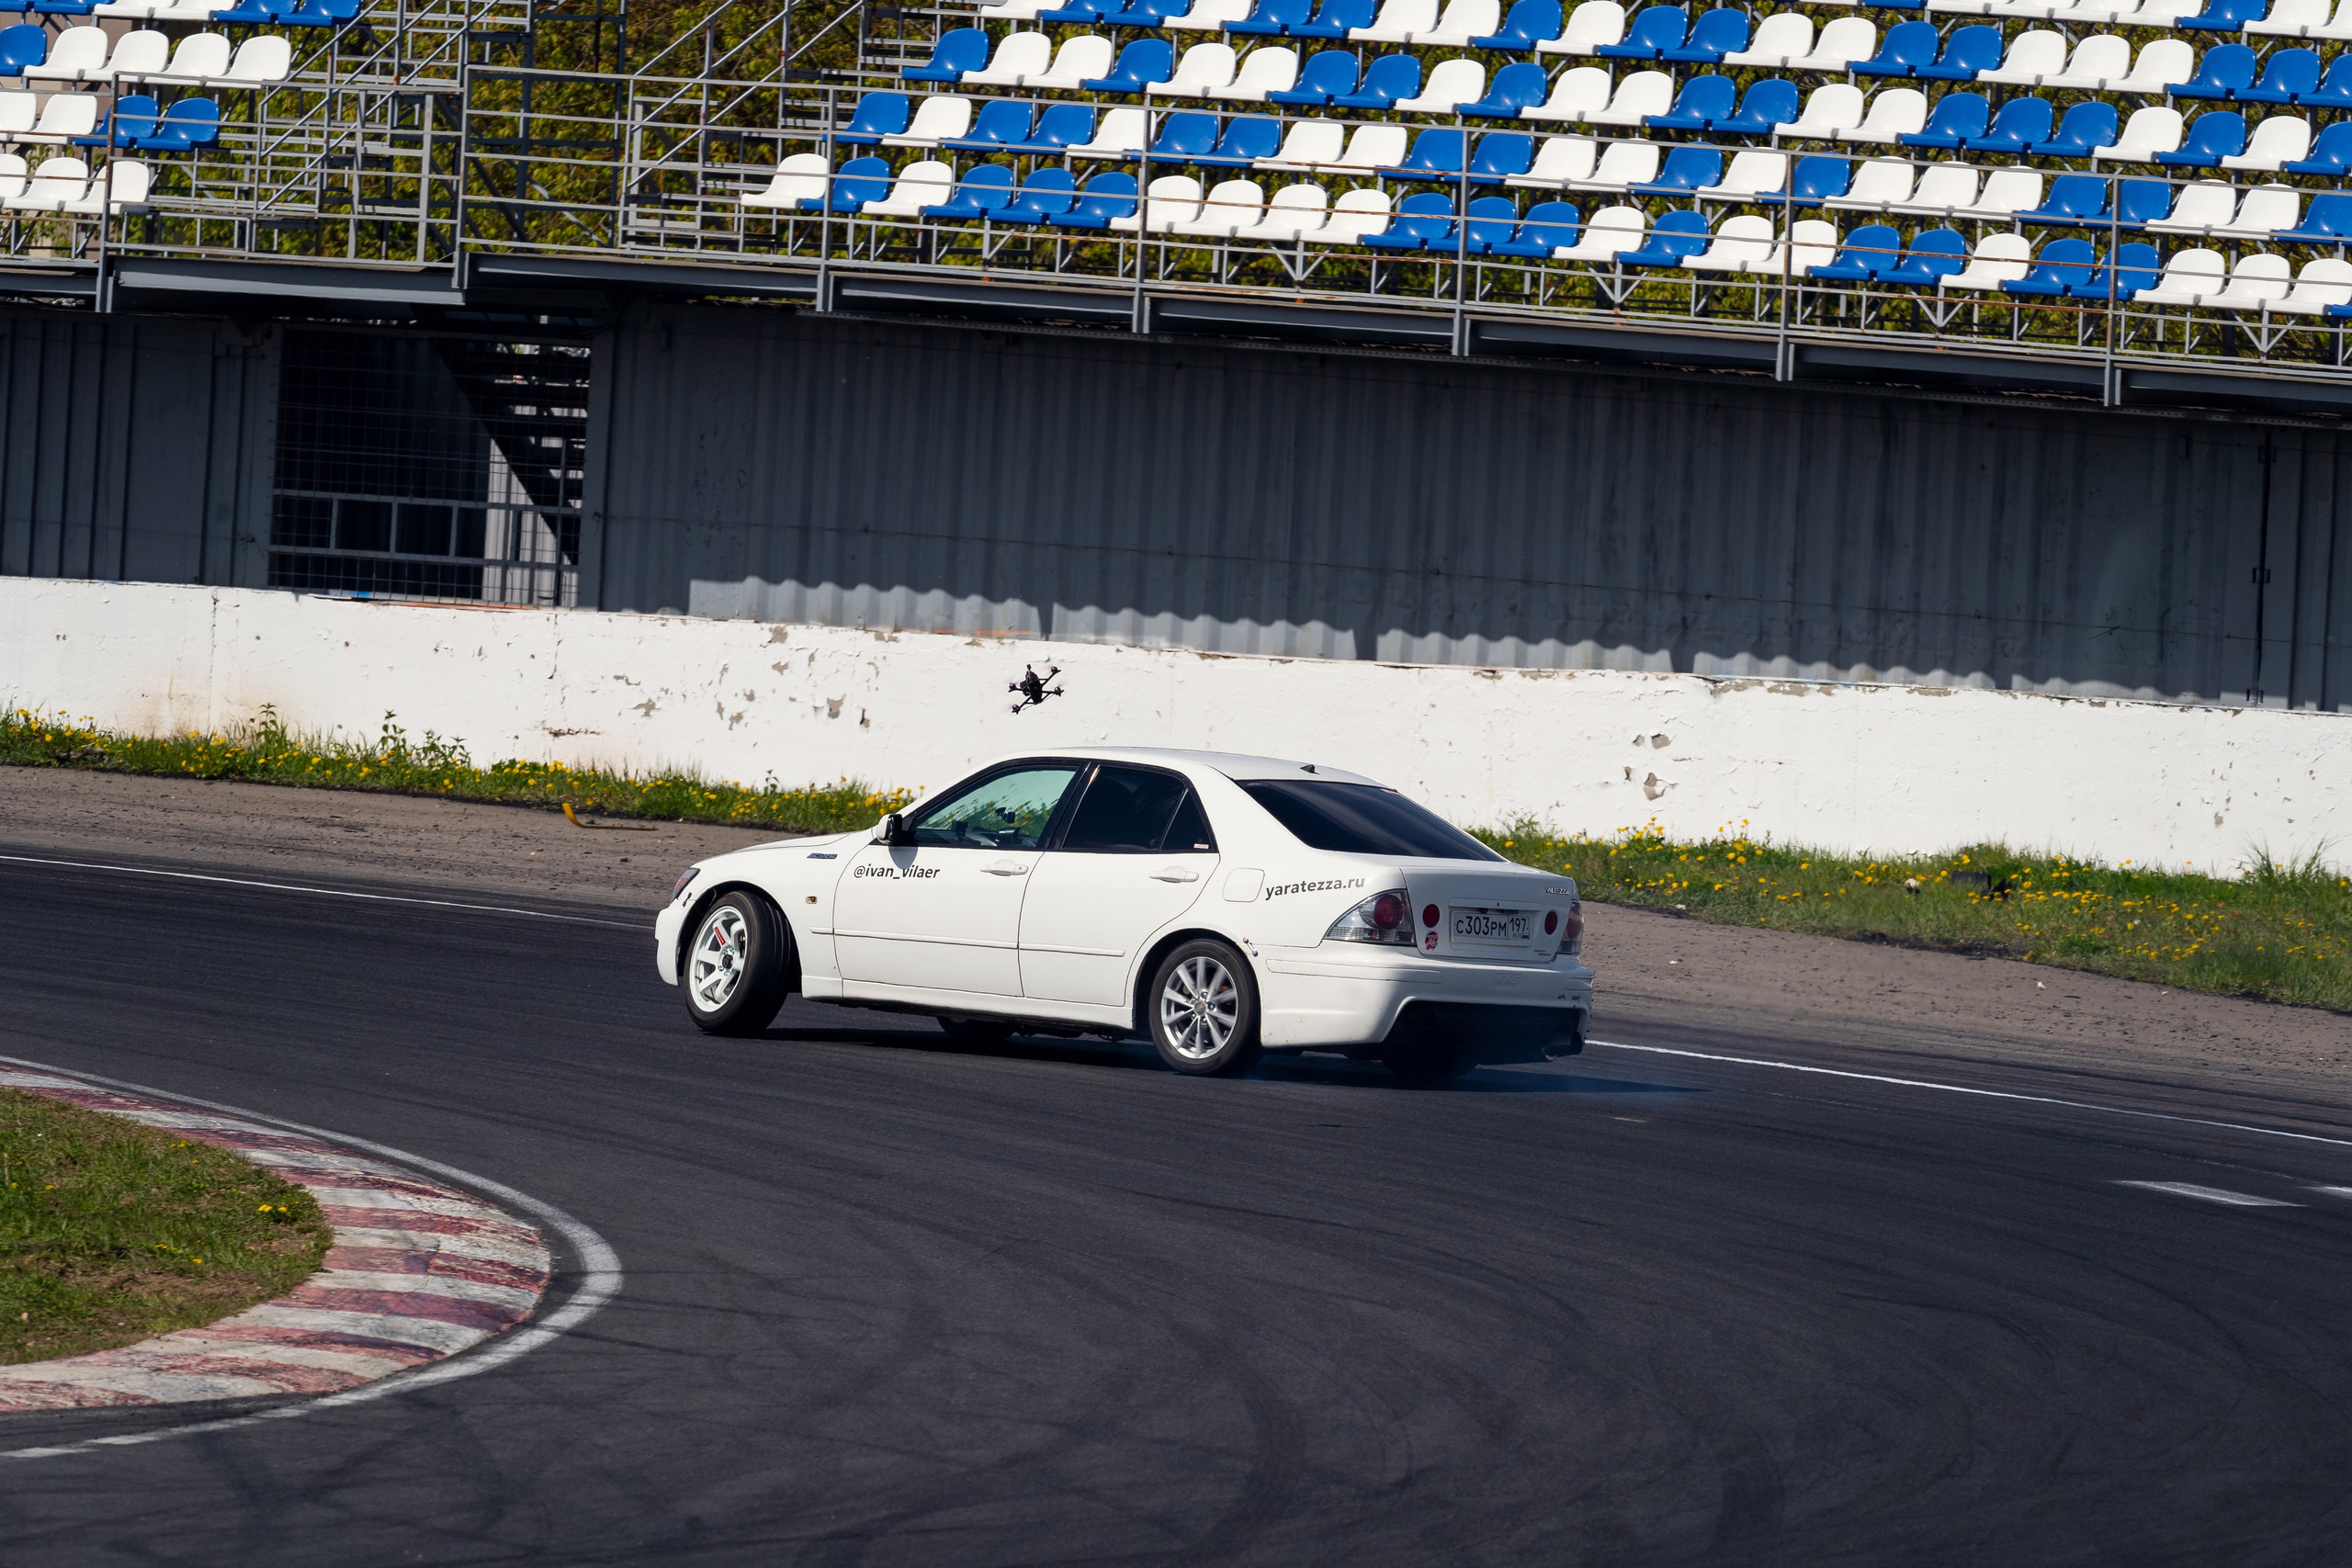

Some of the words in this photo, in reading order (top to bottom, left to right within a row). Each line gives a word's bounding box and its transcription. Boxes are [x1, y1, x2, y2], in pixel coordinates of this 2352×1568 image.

[854, 863, 940, 879] @ivan_vilaer
[1265, 878, 1365, 901] yaratezza.ru
[1510, 917, 1527, 932] 197
